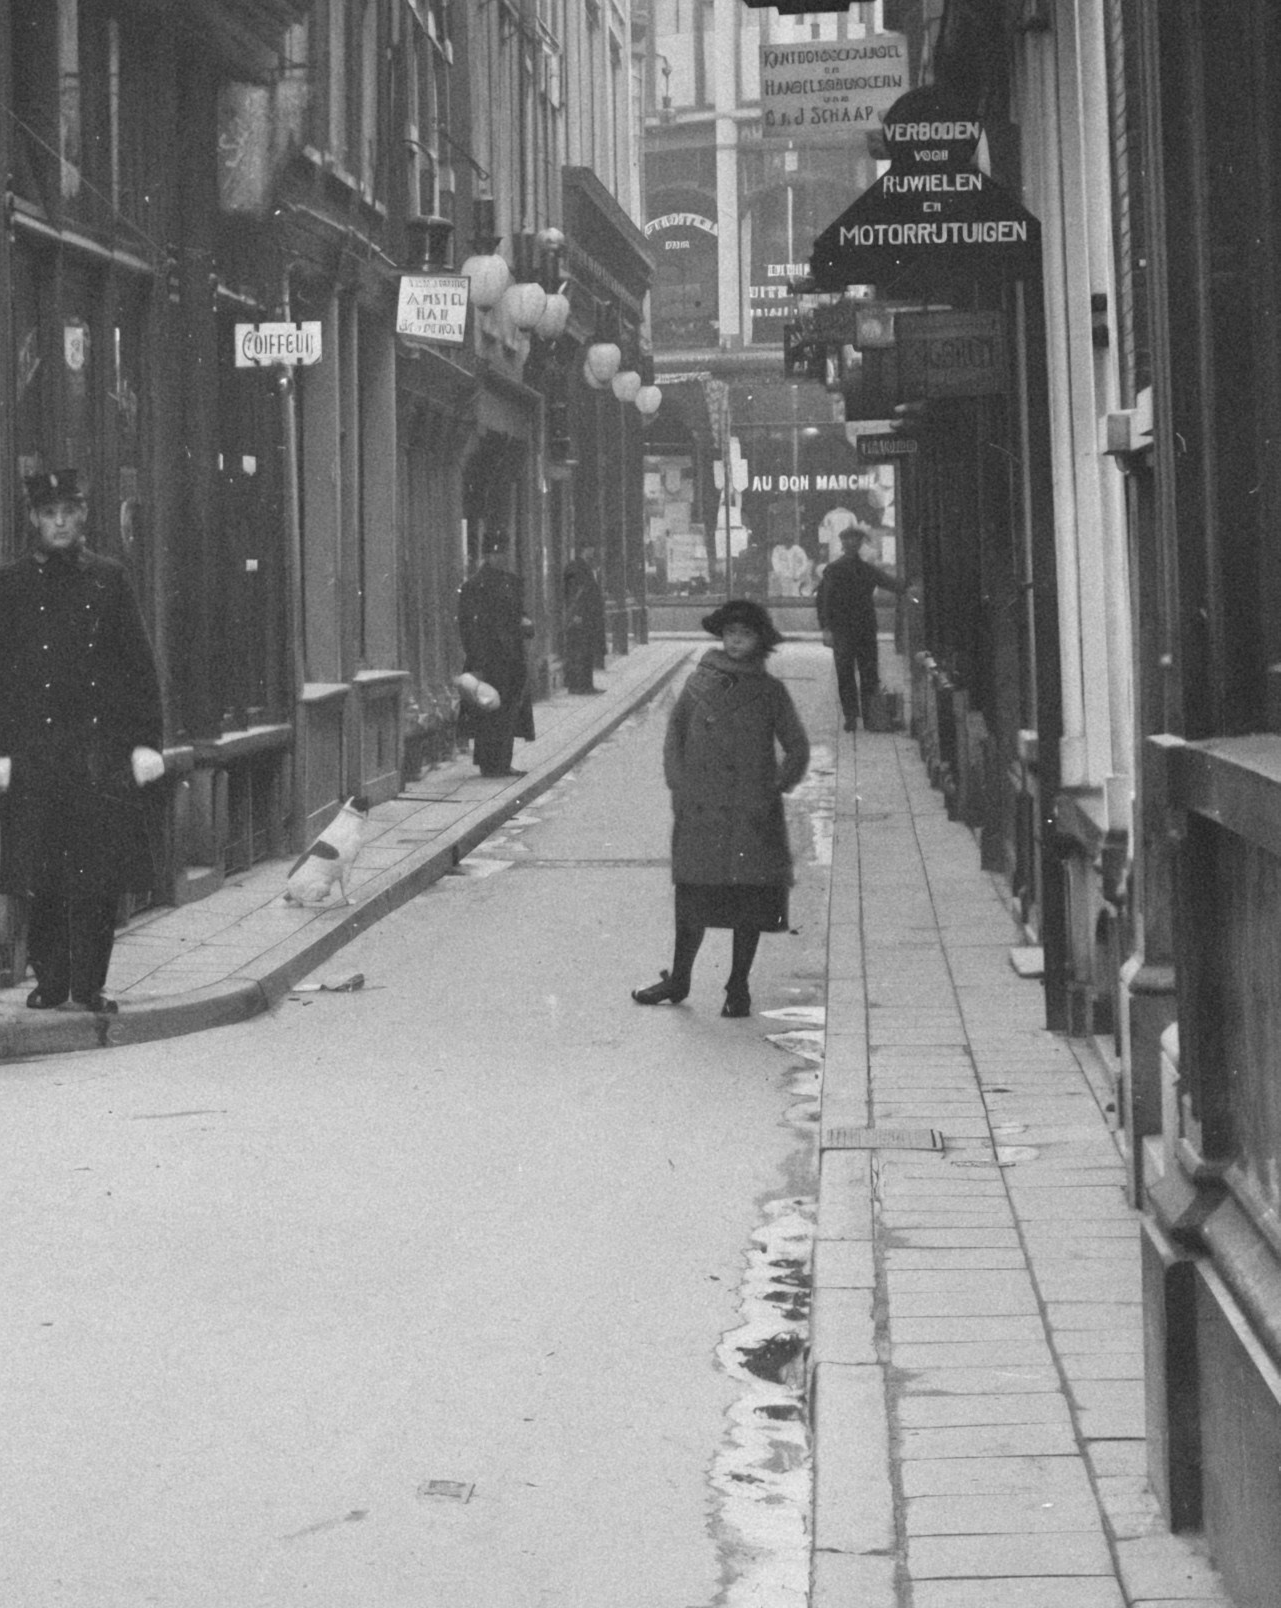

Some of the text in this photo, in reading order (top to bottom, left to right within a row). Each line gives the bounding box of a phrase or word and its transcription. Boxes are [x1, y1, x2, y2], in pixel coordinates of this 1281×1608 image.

[811, 105, 874, 125] SCHAAP
[883, 121, 980, 142] VERBODEN
[242, 330, 314, 361] COIFFEUR
[752, 475, 772, 492] AU
[778, 474, 809, 492] BON
